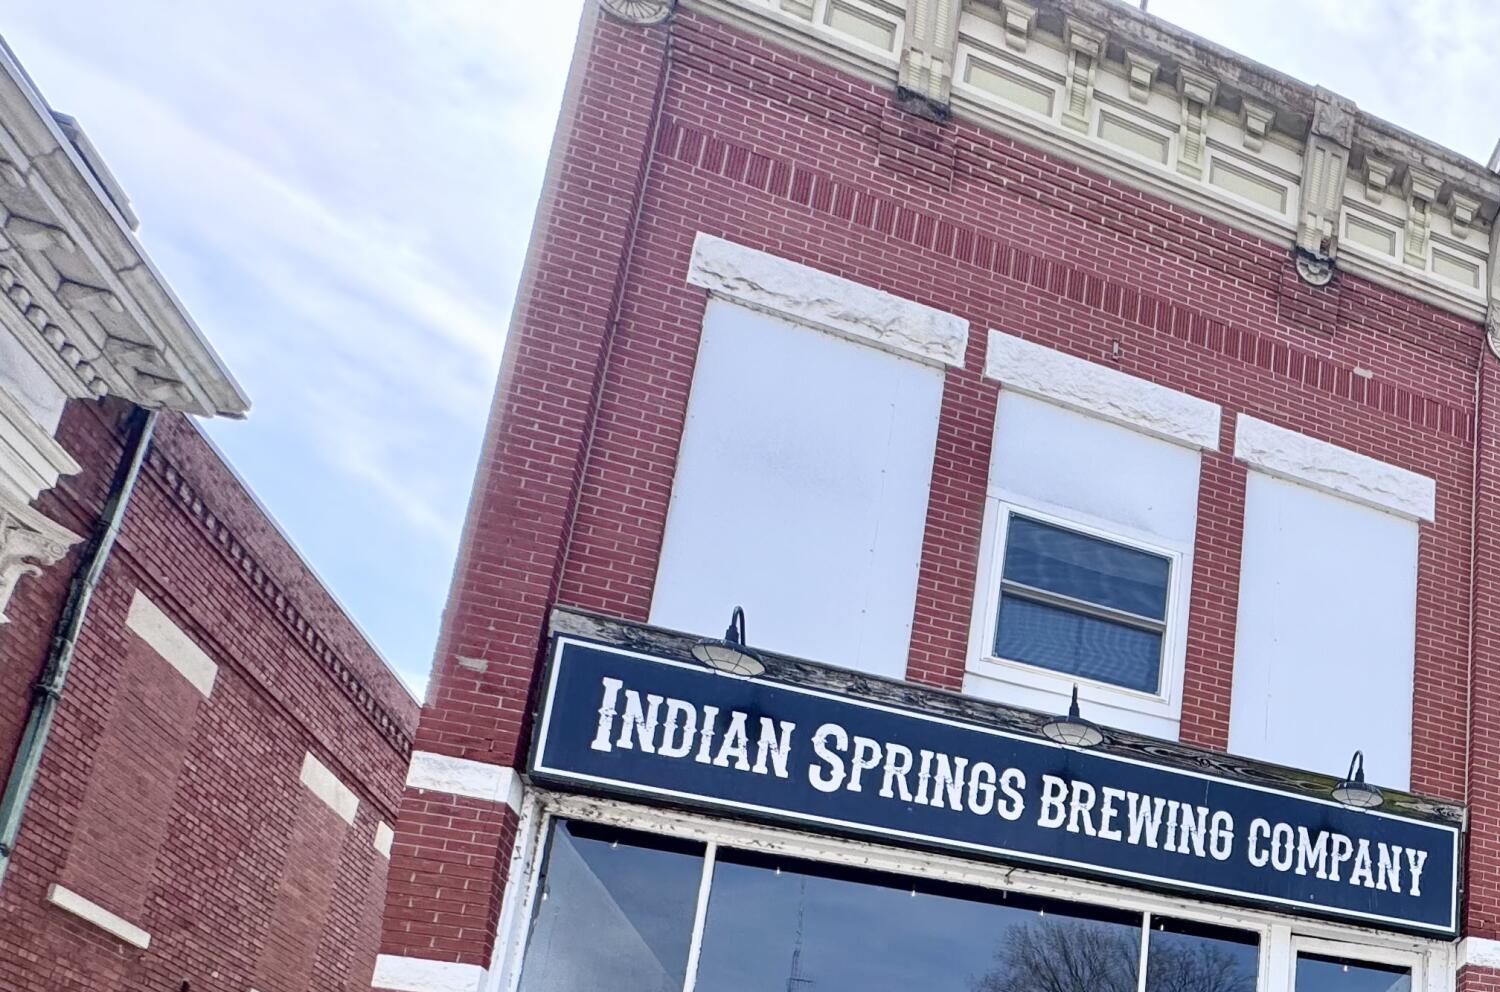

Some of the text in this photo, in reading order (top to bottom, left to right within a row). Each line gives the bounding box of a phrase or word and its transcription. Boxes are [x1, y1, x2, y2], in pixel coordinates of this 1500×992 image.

[591, 677, 1428, 897] INDIAN SPRINGS BREWING COMPANY
